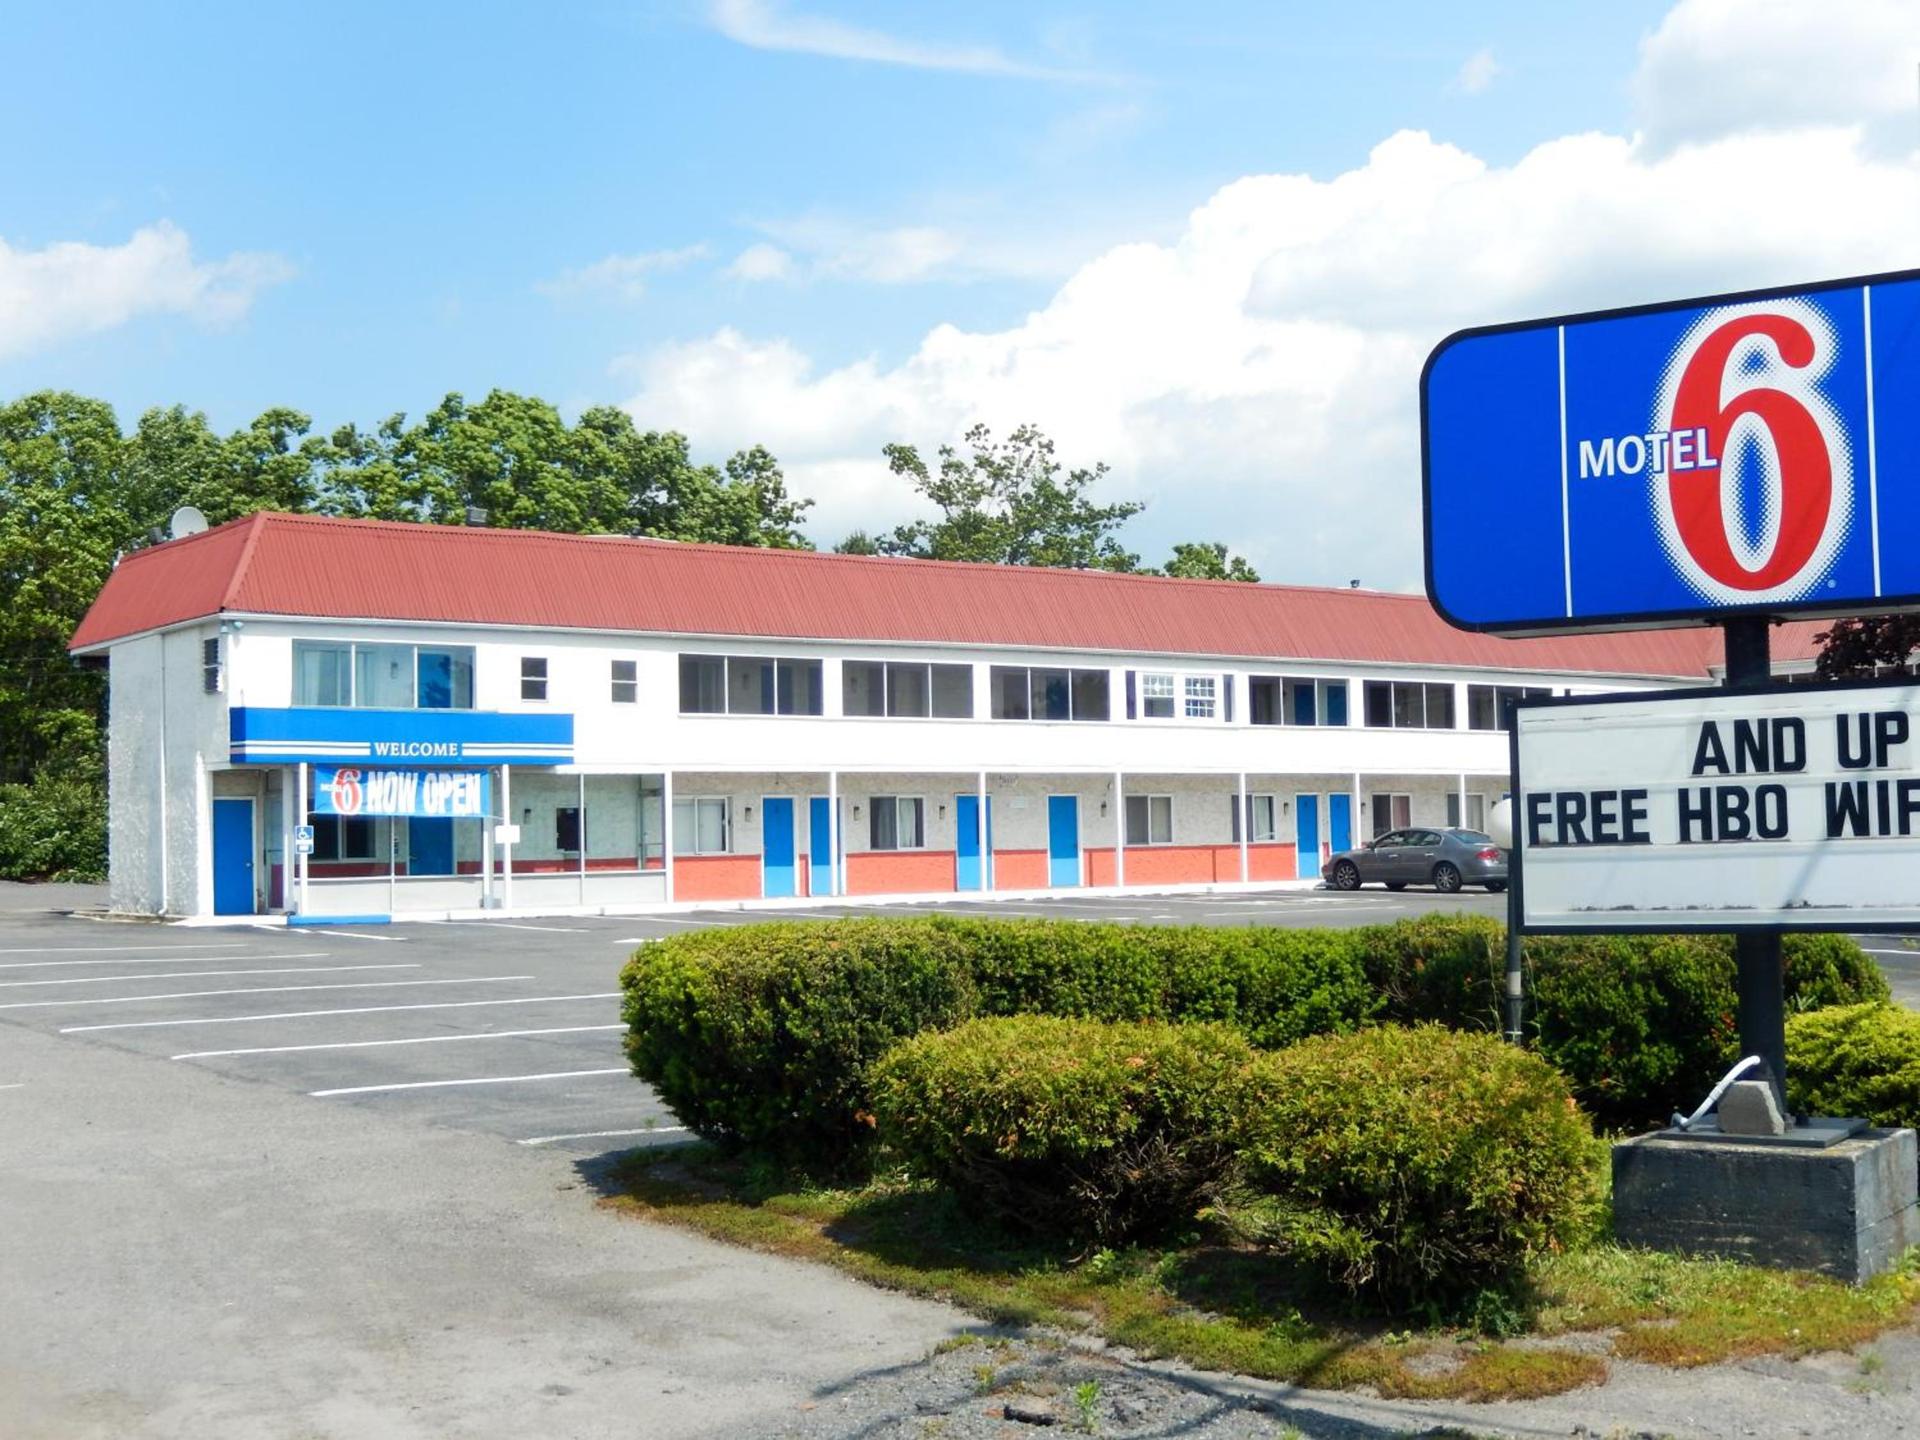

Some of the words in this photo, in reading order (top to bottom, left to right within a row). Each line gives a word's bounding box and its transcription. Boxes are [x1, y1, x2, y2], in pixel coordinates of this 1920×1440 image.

[1580, 428, 1718, 478] MOTEL
[1666, 310, 1835, 594] 6
[374, 742, 459, 756] WELCOME
[1692, 717, 1806, 775] AND
[1836, 711, 1909, 769] UP
[332, 769, 362, 815] 6
[366, 771, 418, 813] NOW
[423, 773, 481, 815] OPEN
[1527, 789, 1651, 845] FREE
[1678, 784, 1788, 841] HBO
